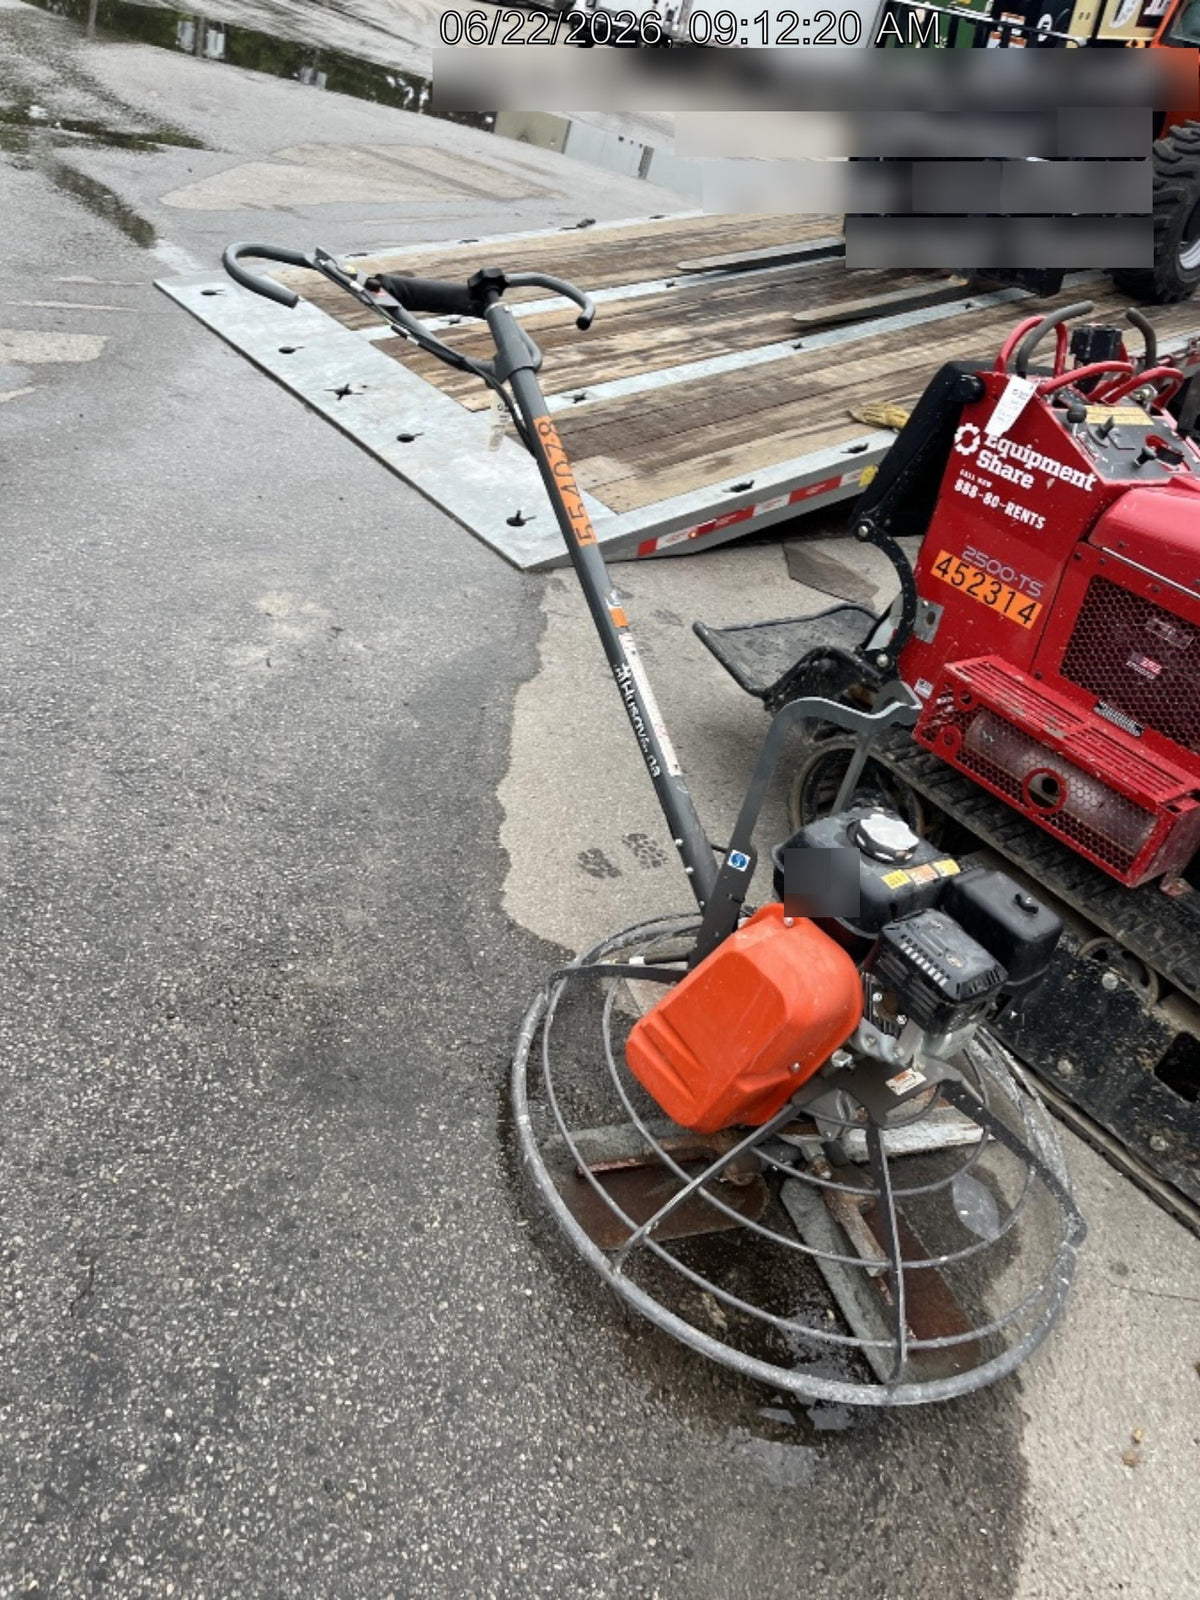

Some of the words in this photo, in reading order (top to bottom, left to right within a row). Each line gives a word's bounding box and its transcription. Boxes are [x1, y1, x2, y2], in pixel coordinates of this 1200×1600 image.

[976, 449, 1035, 490] Share
[984, 433, 1097, 492] Equipment
[935, 555, 1038, 625] 452314
